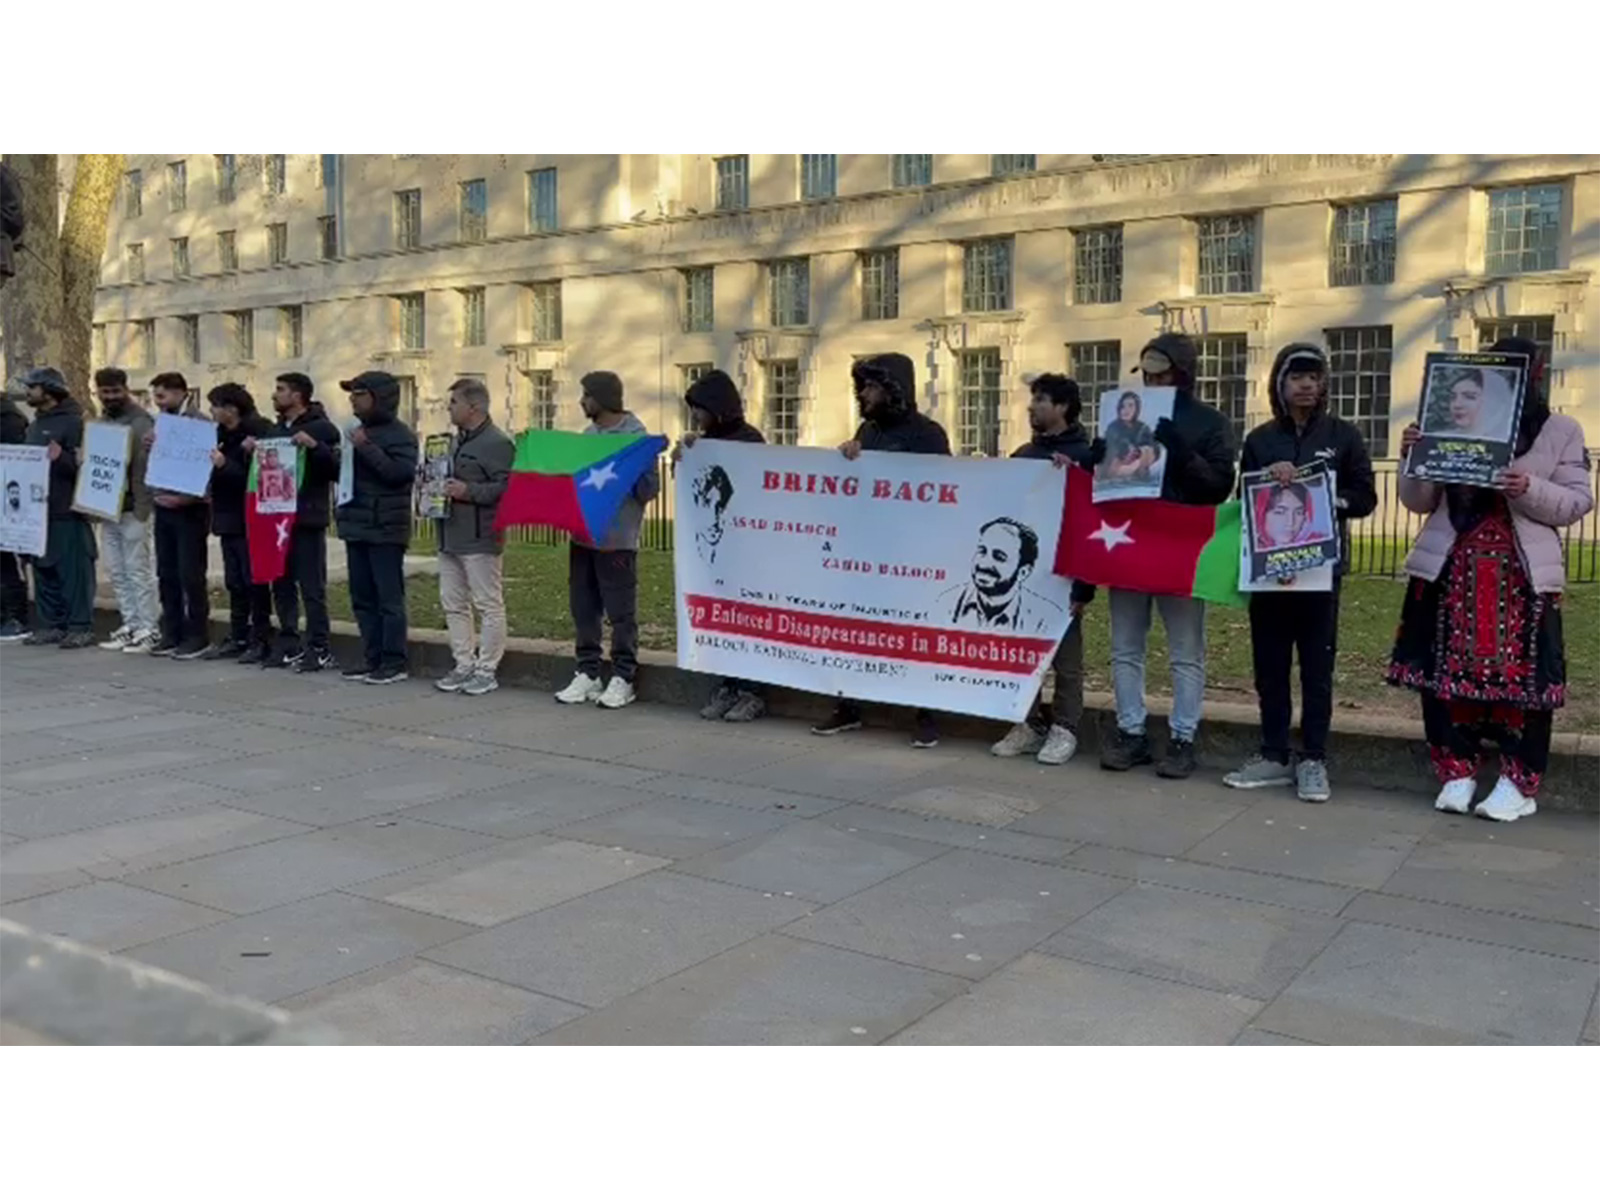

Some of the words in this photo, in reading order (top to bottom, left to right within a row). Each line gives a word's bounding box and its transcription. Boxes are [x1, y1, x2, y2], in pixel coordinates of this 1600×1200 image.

[763, 470, 860, 498] BRING
[872, 479, 959, 505] BACK
[774, 520, 838, 537] BALOCH
[822, 541, 833, 552] &
[822, 557, 872, 573] ZAHID
[878, 563, 947, 581] BALOCH
[785, 595, 826, 609] YEARS
[829, 602, 846, 612] OF
[688, 604, 706, 622] op
[711, 603, 774, 631] Enforced
[777, 614, 905, 649] Disappearances
[911, 631, 929, 654] in
